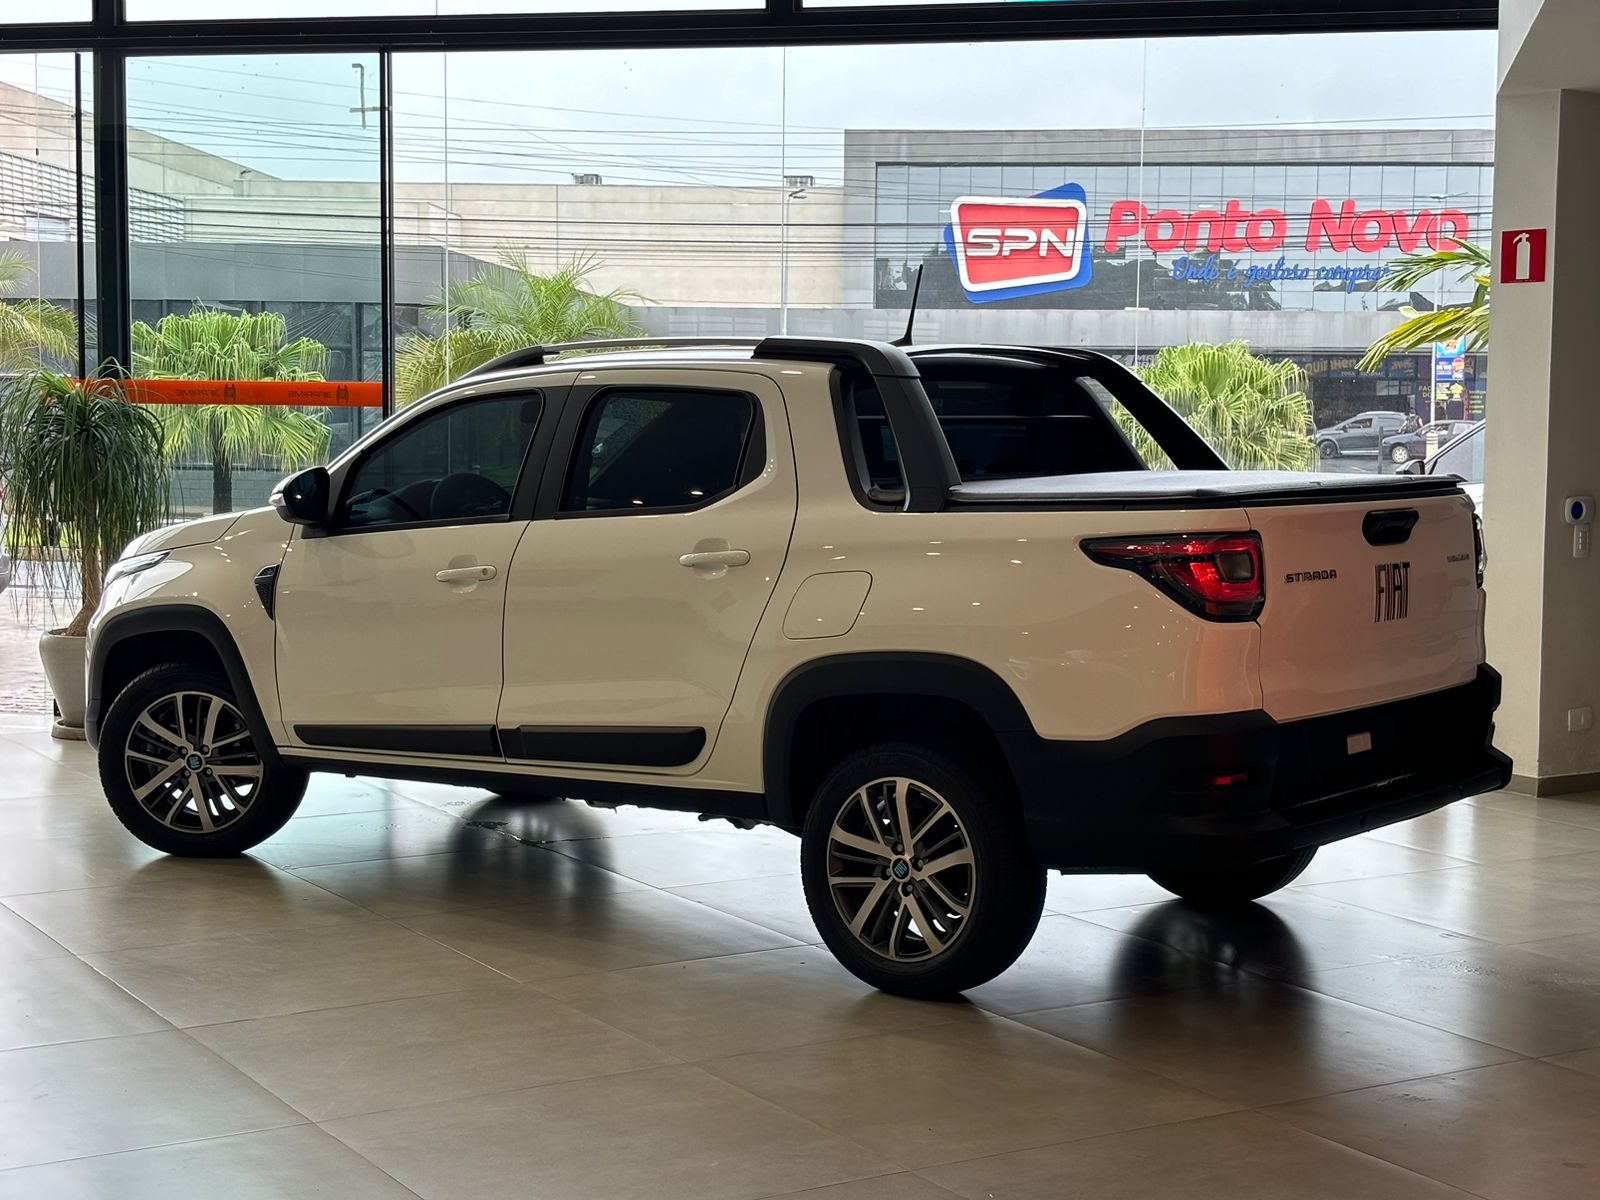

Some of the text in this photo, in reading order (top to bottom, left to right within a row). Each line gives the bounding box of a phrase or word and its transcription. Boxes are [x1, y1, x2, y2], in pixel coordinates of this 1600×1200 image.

[965, 228, 1075, 258] SPN
[1103, 199, 1470, 253] Ponto Novo
[1172, 254, 1219, 280] Onde
[1242, 256, 1310, 288] gostoso
[1284, 569, 1337, 583] STRADA
[1374, 561, 1411, 623] FIAT
